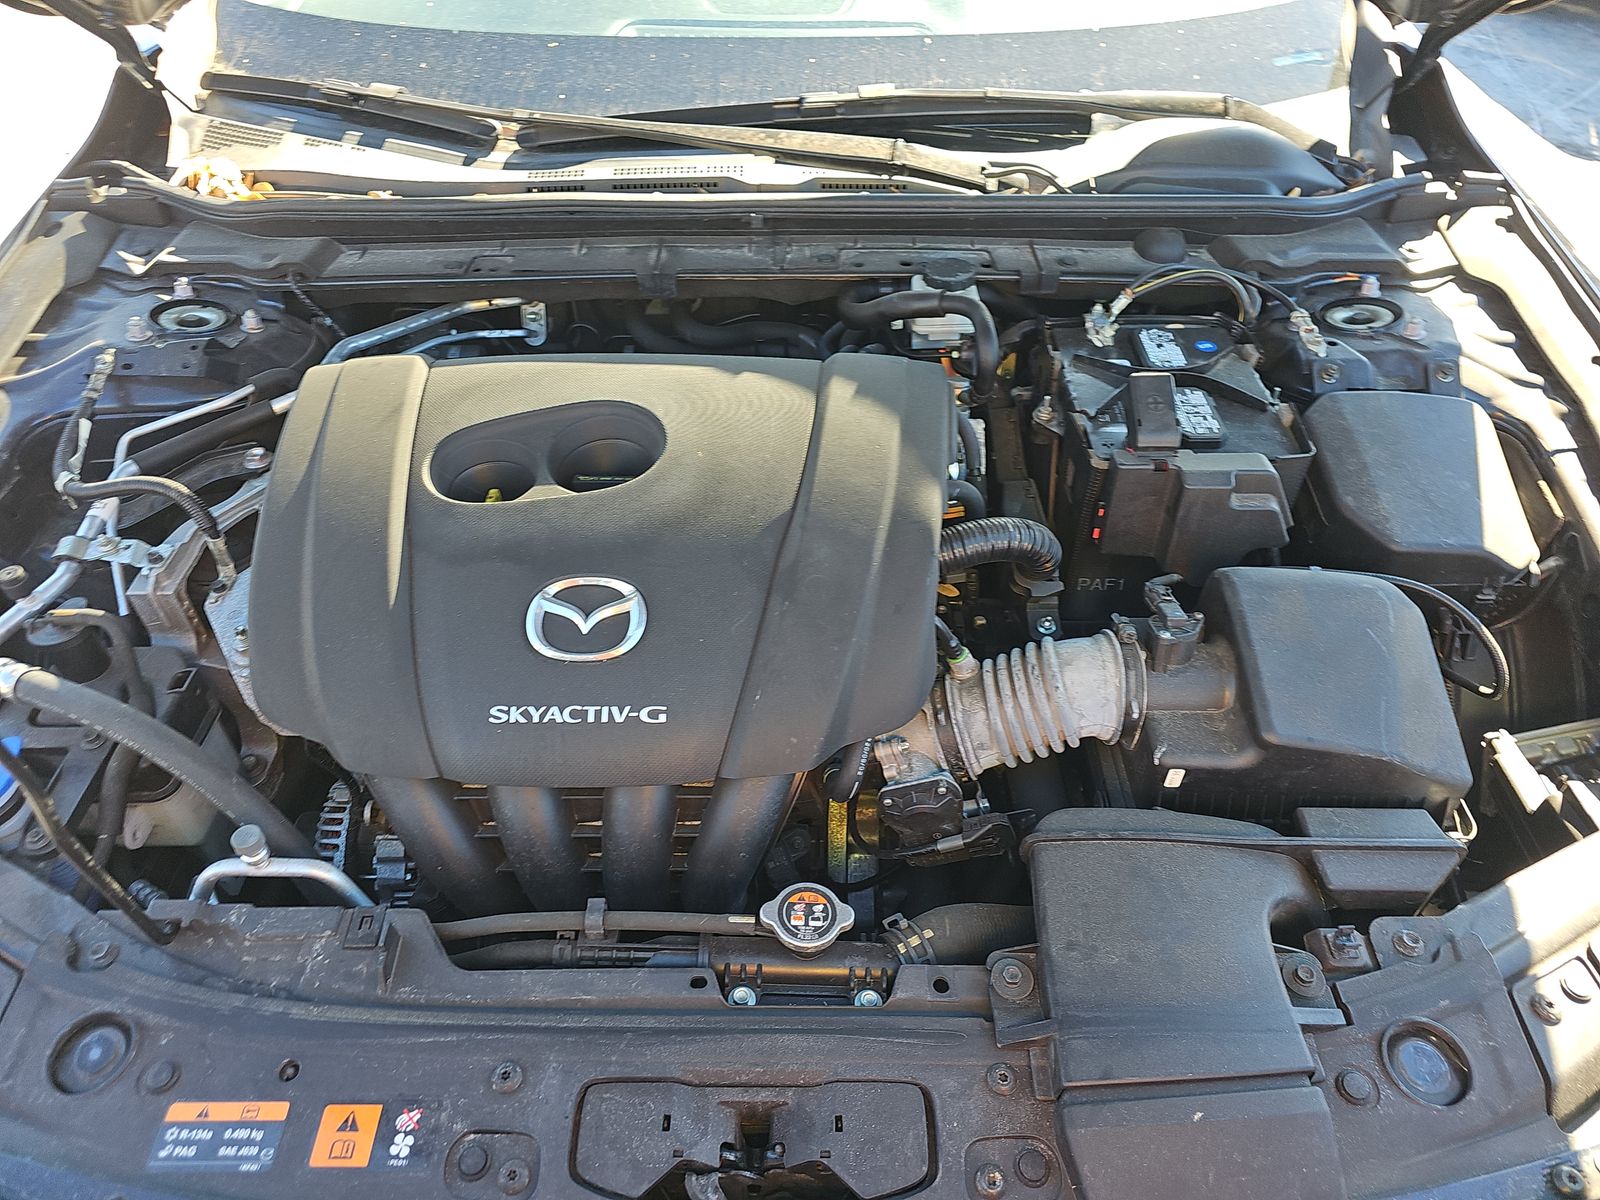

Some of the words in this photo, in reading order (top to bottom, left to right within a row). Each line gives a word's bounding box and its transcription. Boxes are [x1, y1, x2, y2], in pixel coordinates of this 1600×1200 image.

[1077, 577, 1125, 591] PAF1
[488, 705, 668, 724] SKYACTIV-G
[172, 1144, 198, 1157] PAG
